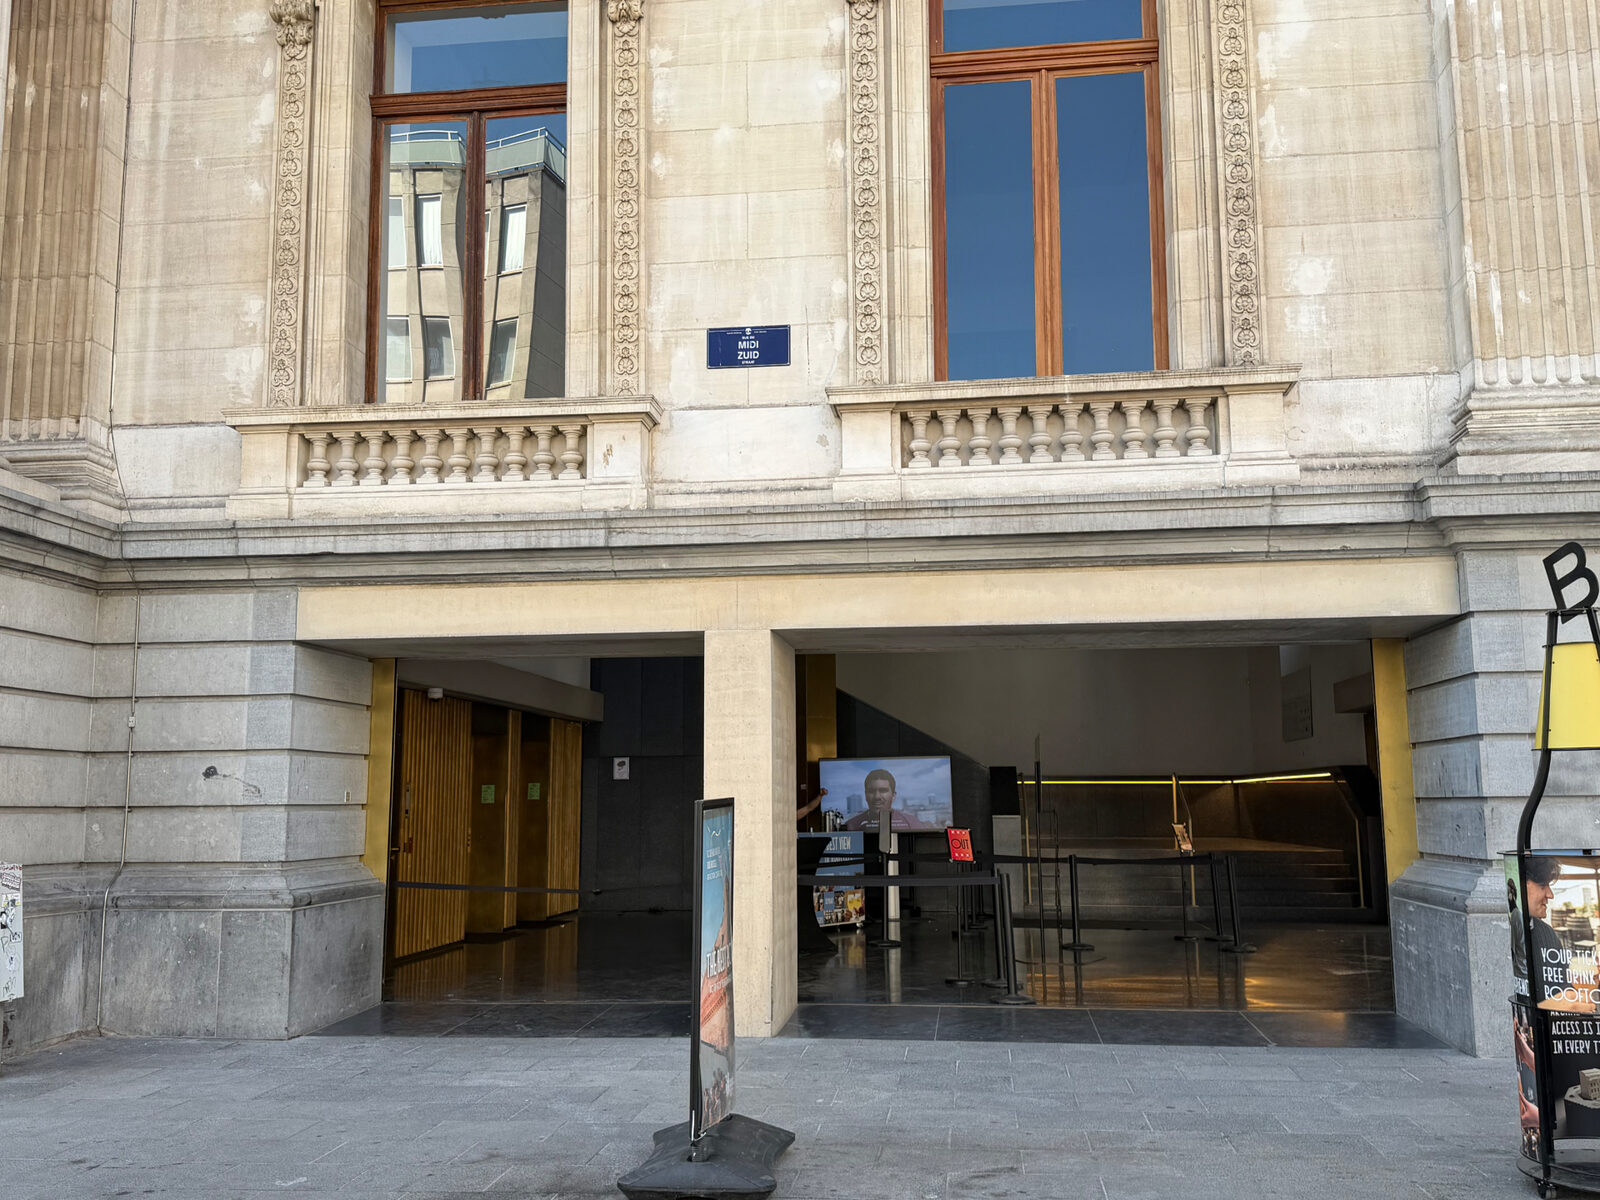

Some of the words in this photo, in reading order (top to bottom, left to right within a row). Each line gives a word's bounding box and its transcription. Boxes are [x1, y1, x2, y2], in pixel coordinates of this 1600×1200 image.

[738, 340, 759, 349] MIDI
[737, 351, 760, 360] ZUID
[950, 838, 969, 850] OUT
[1541, 947, 1572, 964] YOUR
[1542, 966, 1564, 983] FREE
[1566, 968, 1596, 985] DRINK
[1551, 1020, 1581, 1035] ACCESS
[1582, 1020, 1594, 1035] IS
[1552, 1039, 1563, 1055] IN
[1564, 1039, 1590, 1054] EVERY
